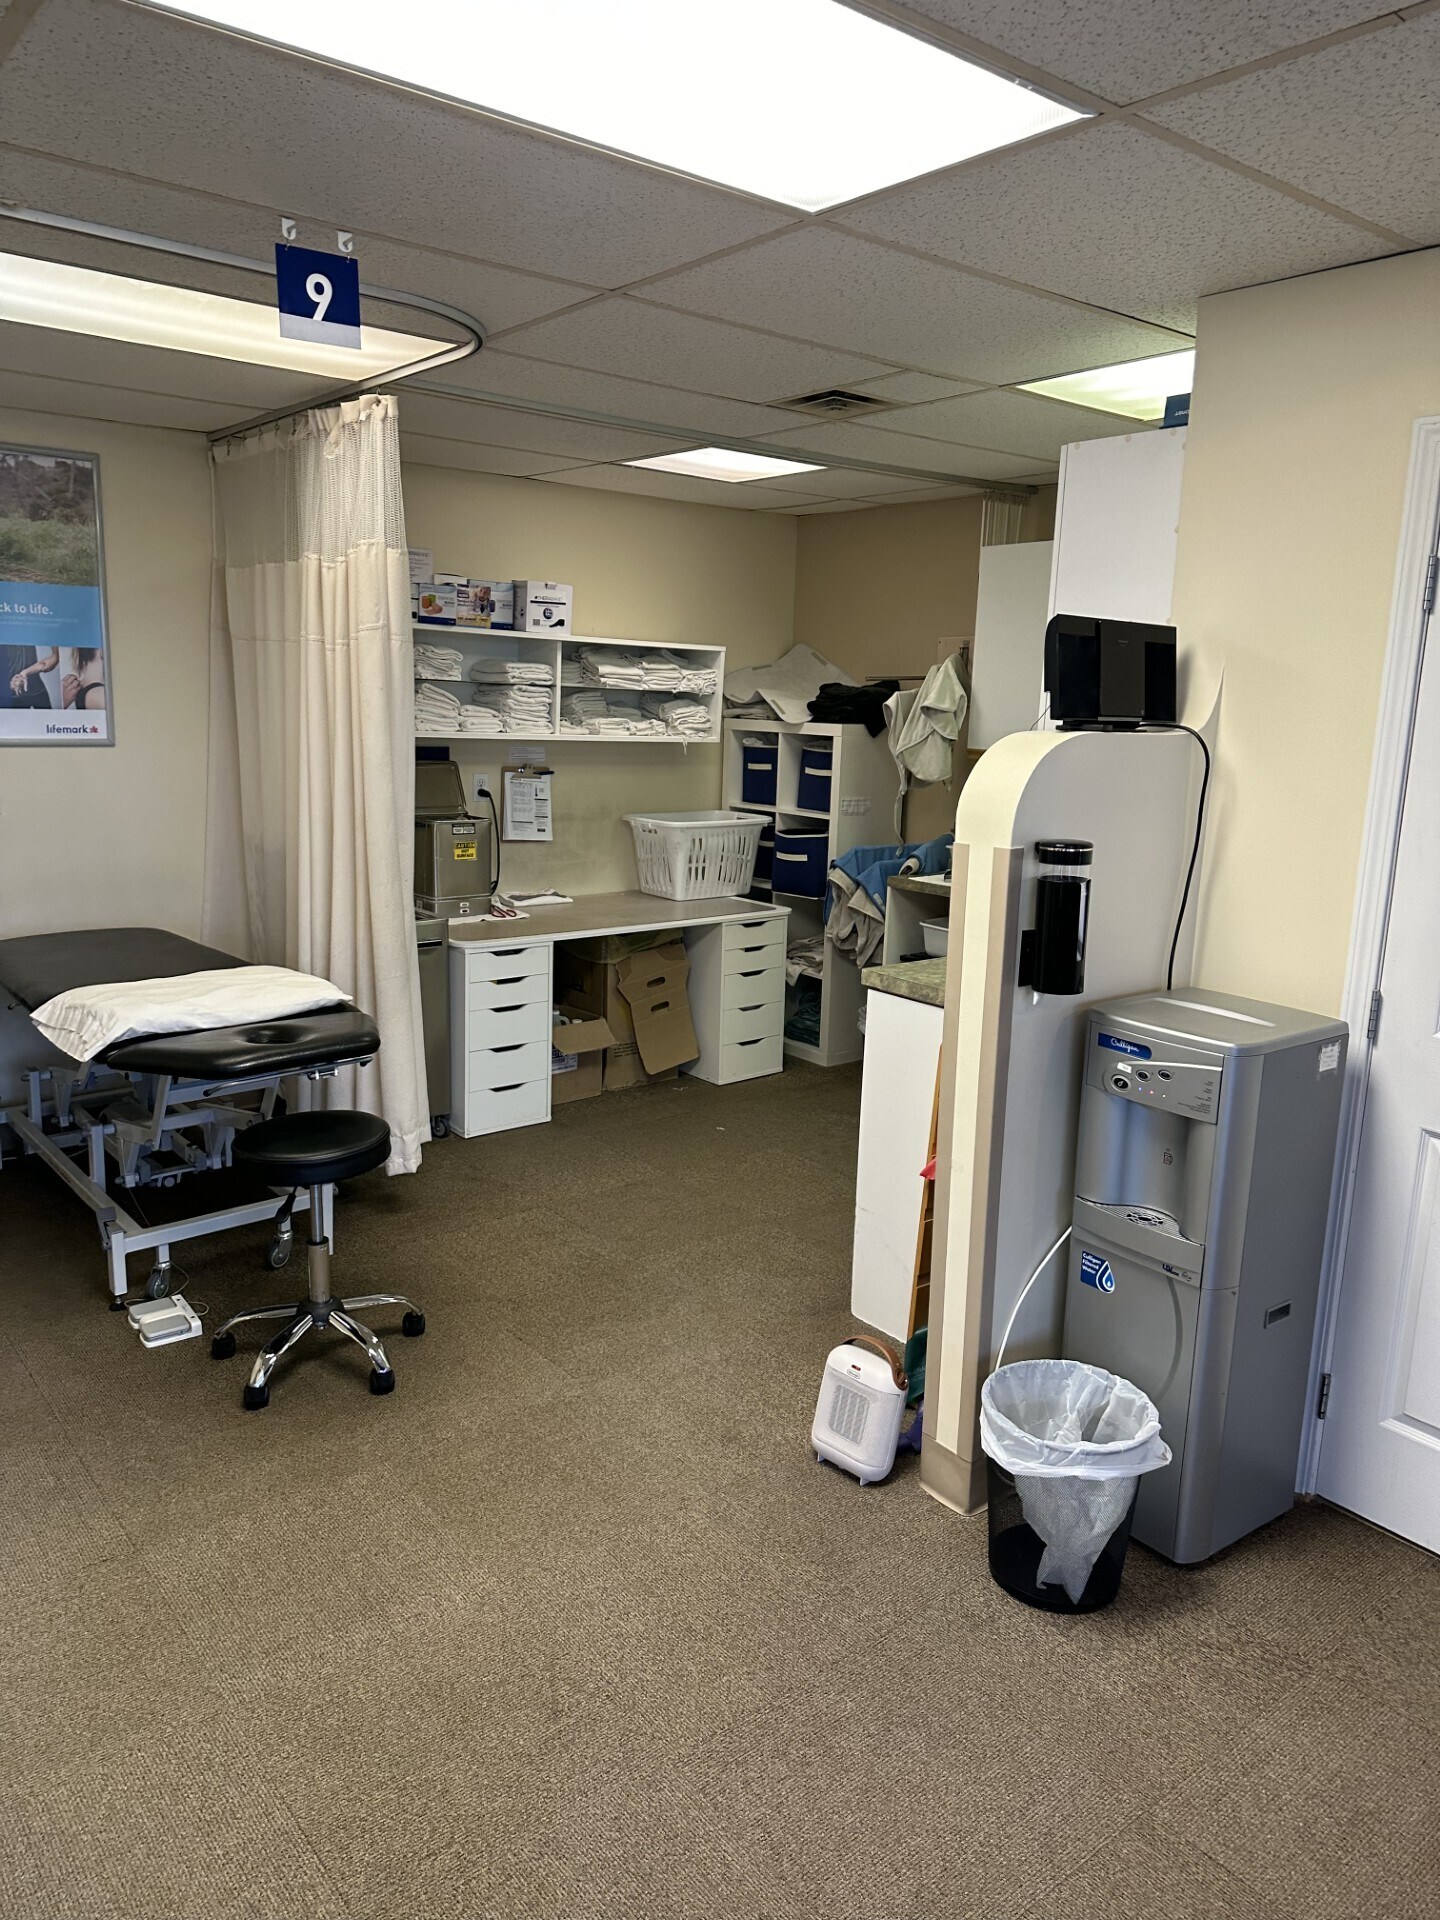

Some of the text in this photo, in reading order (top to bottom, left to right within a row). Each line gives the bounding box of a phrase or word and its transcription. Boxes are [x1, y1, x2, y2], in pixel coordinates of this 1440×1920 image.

[305, 272, 333, 321] 9
[14, 603, 27, 614] to
[29, 603, 54, 615] life.
[46, 724, 89, 734] lifemark
[1110, 1037, 1140, 1053] Culligan
[1082, 1252, 1102, 1265] Culligan
[1081, 1264, 1097, 1275] Water
